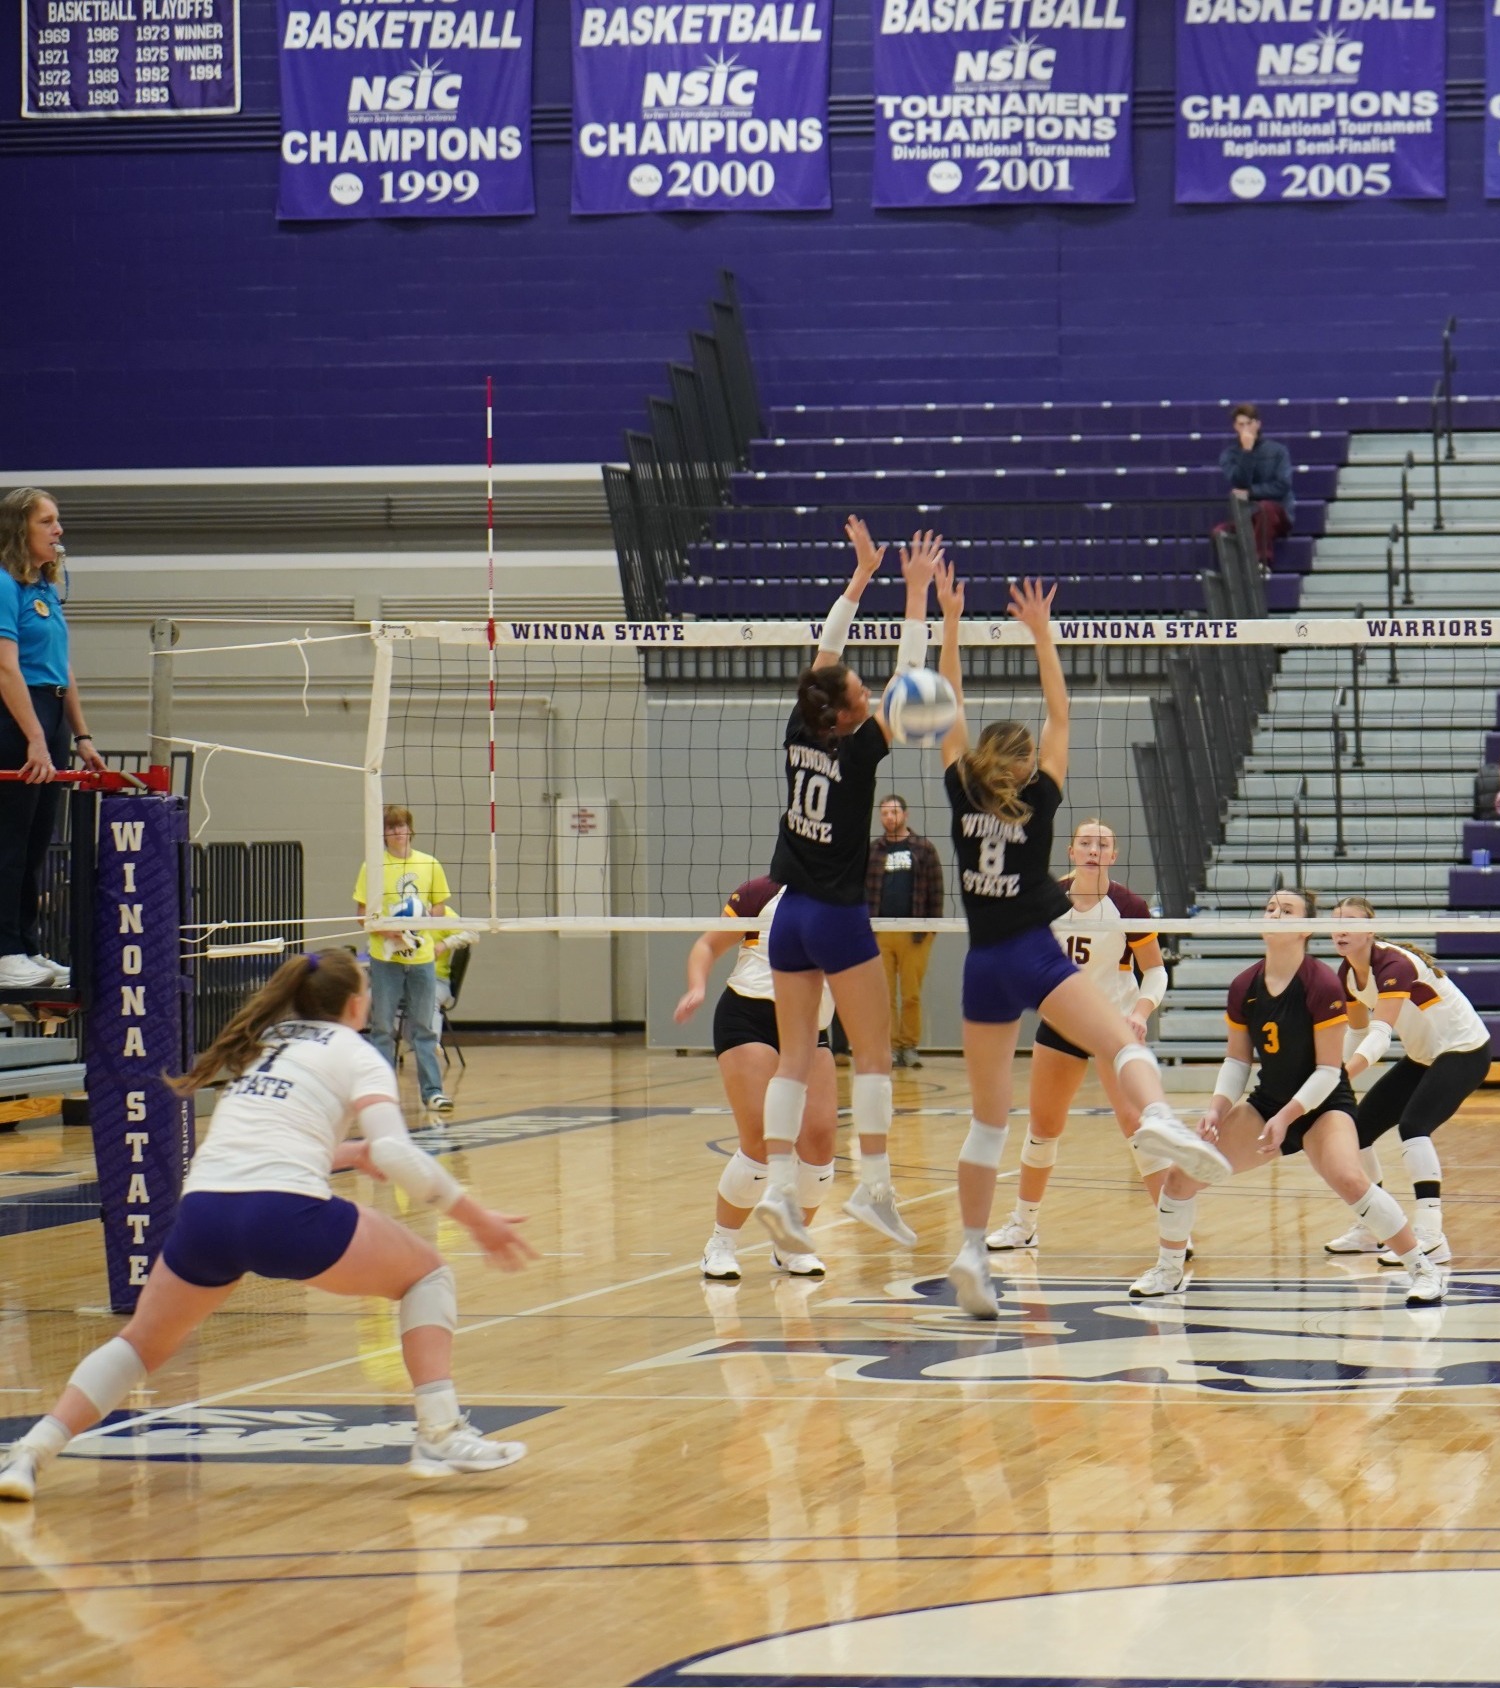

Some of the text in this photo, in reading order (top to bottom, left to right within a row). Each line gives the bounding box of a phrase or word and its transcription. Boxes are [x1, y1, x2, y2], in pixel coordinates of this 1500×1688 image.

[48, 0, 213, 22] BASKETBALL PLAYOFFS
[579, 3, 823, 47] BASKETBALL
[880, 0, 1127, 35] BASKETBALL
[38, 24, 223, 44] 1969 1986 1973 WINNER
[283, 10, 522, 49] BASKETBALL
[38, 45, 223, 65] 1971 1987 1975 WINNER
[954, 43, 1057, 83] NSIC
[1257, 38, 1364, 76] NSIC
[38, 64, 222, 86] 1972 1989 1992 1994
[347, 68, 462, 111] NSIC
[642, 65, 758, 107] NSIC
[38, 88, 169, 106] 1974 1990 1993
[878, 93, 1129, 119] TOURNAMENT
[1181, 90, 1439, 121] CHAMPIONS
[281, 126, 522, 164] CHAMPIONS
[579, 117, 824, 157] CHAMPIONS
[888, 117, 1117, 143] CHAMPIONS
[1188, 122, 1252, 139] Division
[1270, 121, 1335, 137] National
[1338, 119, 1433, 136] Tournament
[892, 142, 1110, 160] Division II National Tournament
[1223, 137, 1396, 159] Regional Semi-Finalist
[379, 170, 480, 204] 1999
[666, 160, 775, 197] 2000
[975, 158, 1074, 192] 2001
[1281, 163, 1391, 198] 2005
[511, 622, 685, 641] WINONA STATE
[810, 623, 932, 640] WRRIO
[1059, 621, 1238, 640] WINONA STATE
[1367, 619, 1493, 638] WARRIORS
[789, 744, 842, 783] WINONA
[792, 769, 830, 821] 10
[787, 808, 833, 843] STATE
[979, 837, 1006, 875] 8
[963, 869, 1020, 898] STATE
[111, 821, 146, 1057] WINONA
[1066, 935, 1092, 965] 15
[1262, 1021, 1280, 1054] 3
[125, 1091, 149, 1286] STATE
